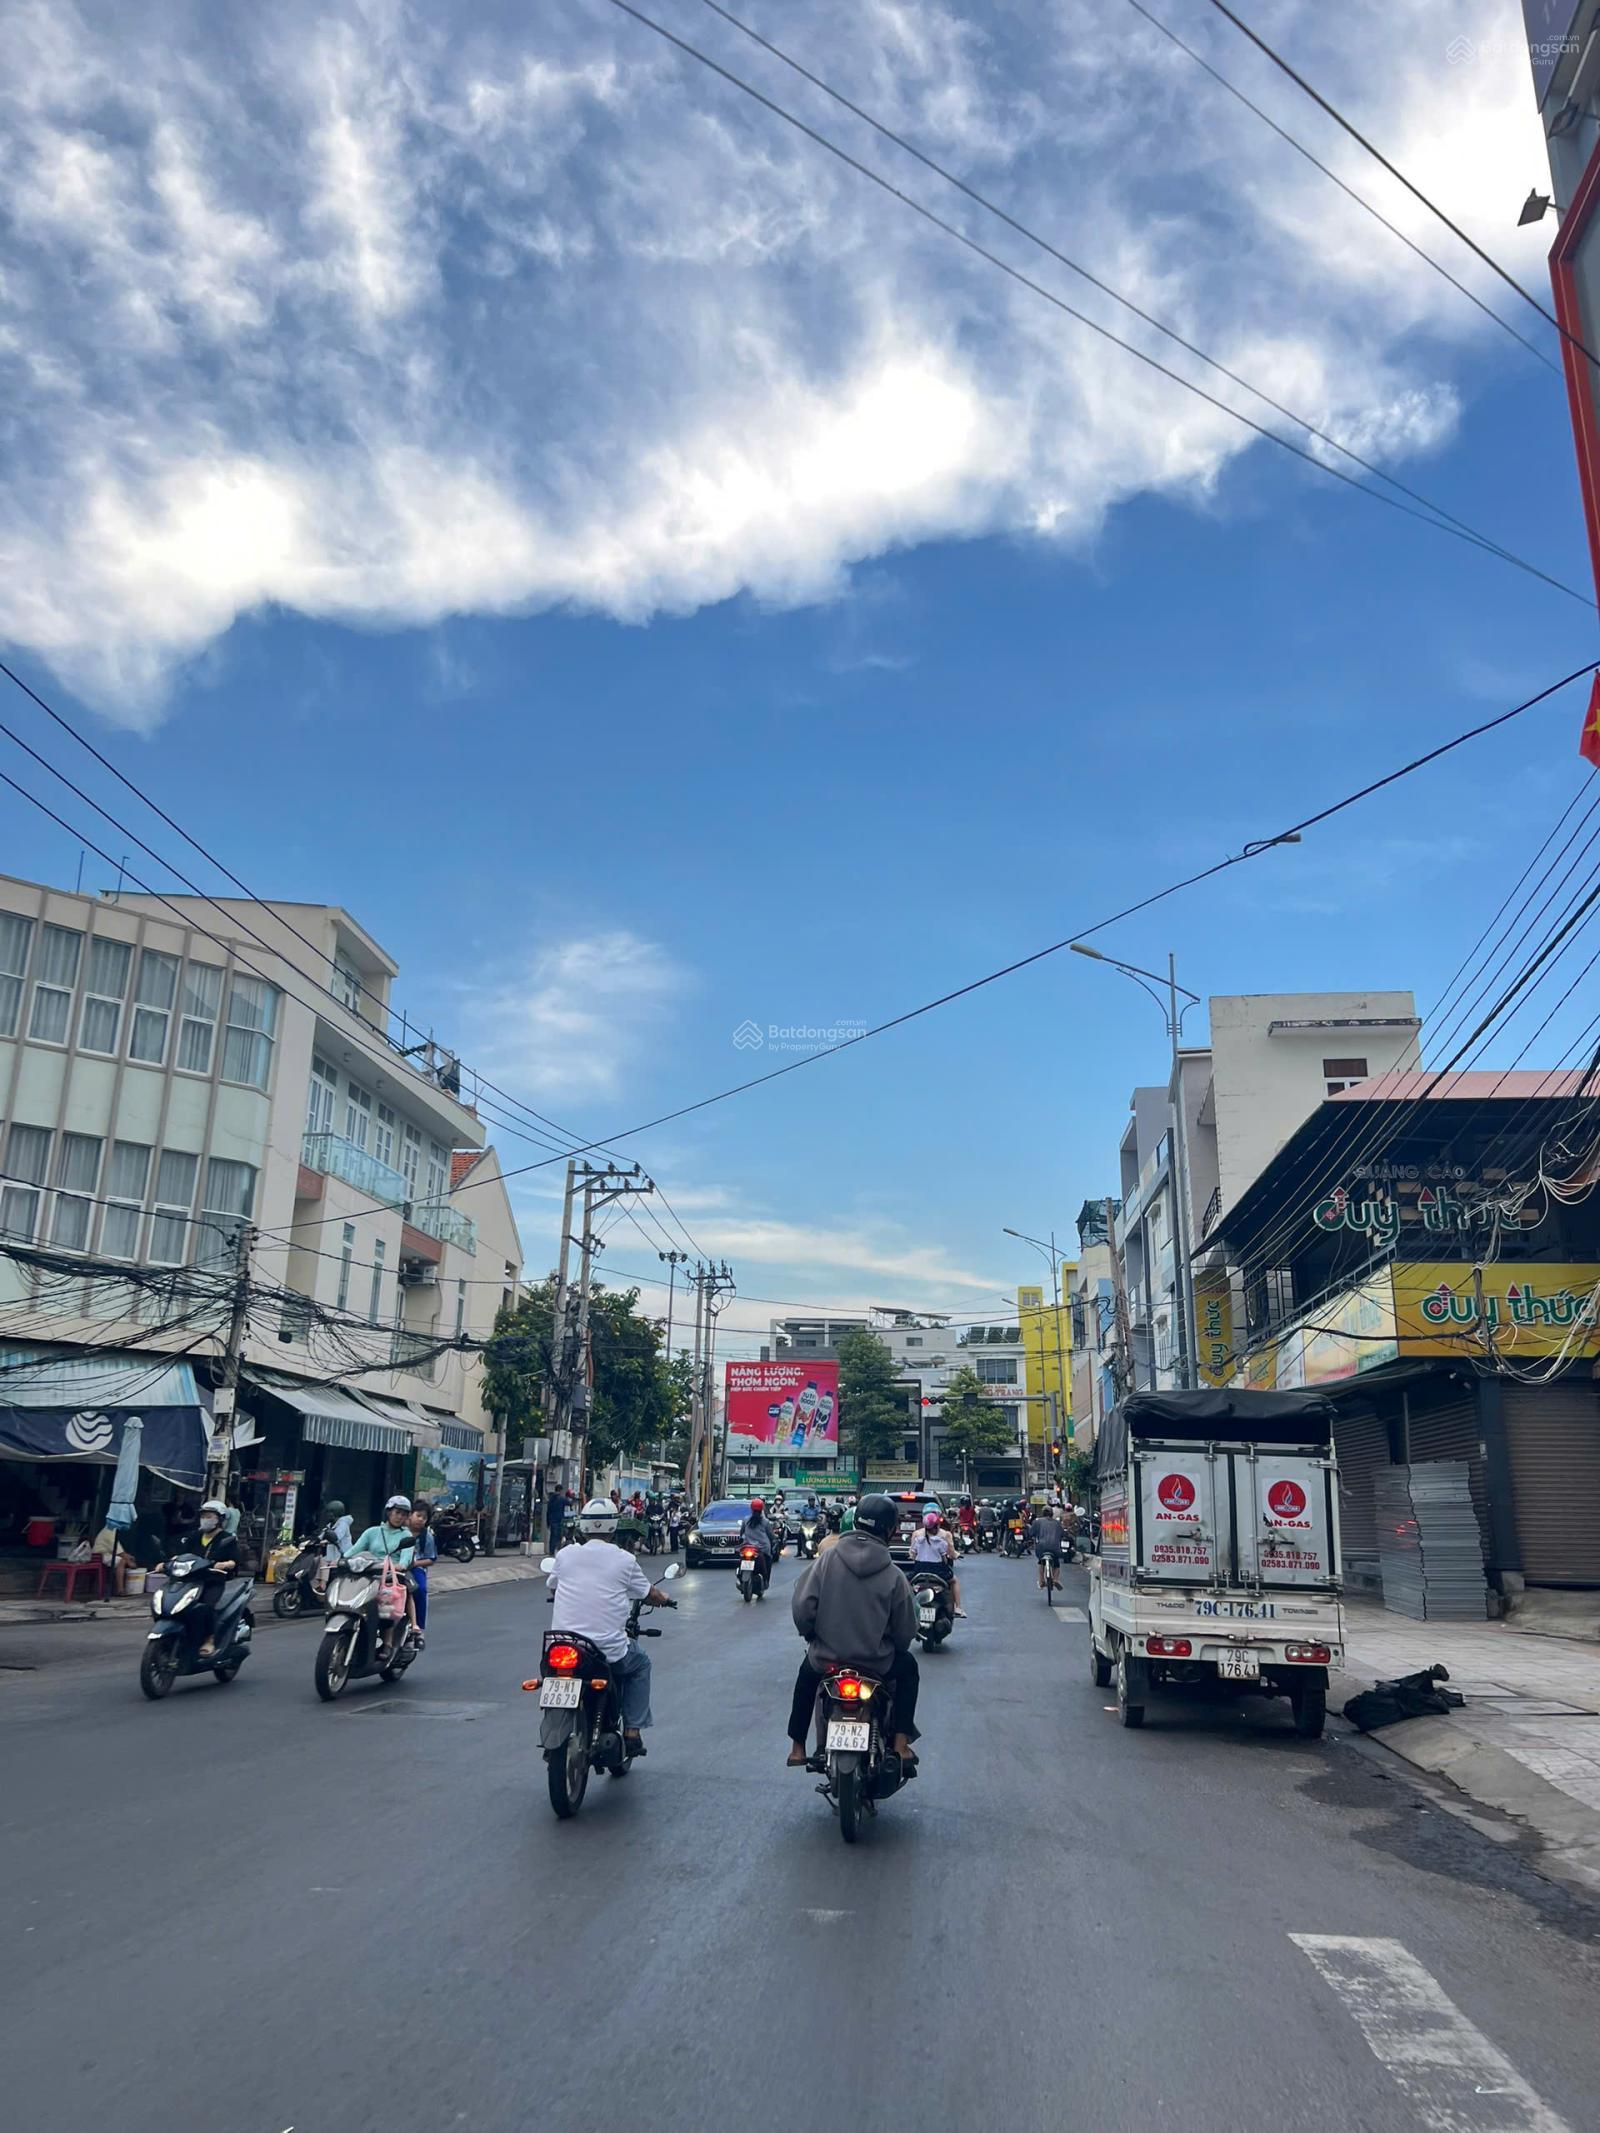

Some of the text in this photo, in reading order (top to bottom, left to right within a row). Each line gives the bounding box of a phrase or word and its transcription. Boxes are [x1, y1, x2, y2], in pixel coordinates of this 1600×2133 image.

[1155, 1512, 1200, 1522] AN-GAS
[1154, 1544, 1207, 1556] 0935.818.757
[1195, 1601, 1276, 1618] 79C-176.41
[1227, 1649, 1249, 1662] 79C
[1219, 1662, 1257, 1677] 176.41
[549, 1680, 576, 1693] 79-N1
[834, 1724, 863, 1737] 79-N2
